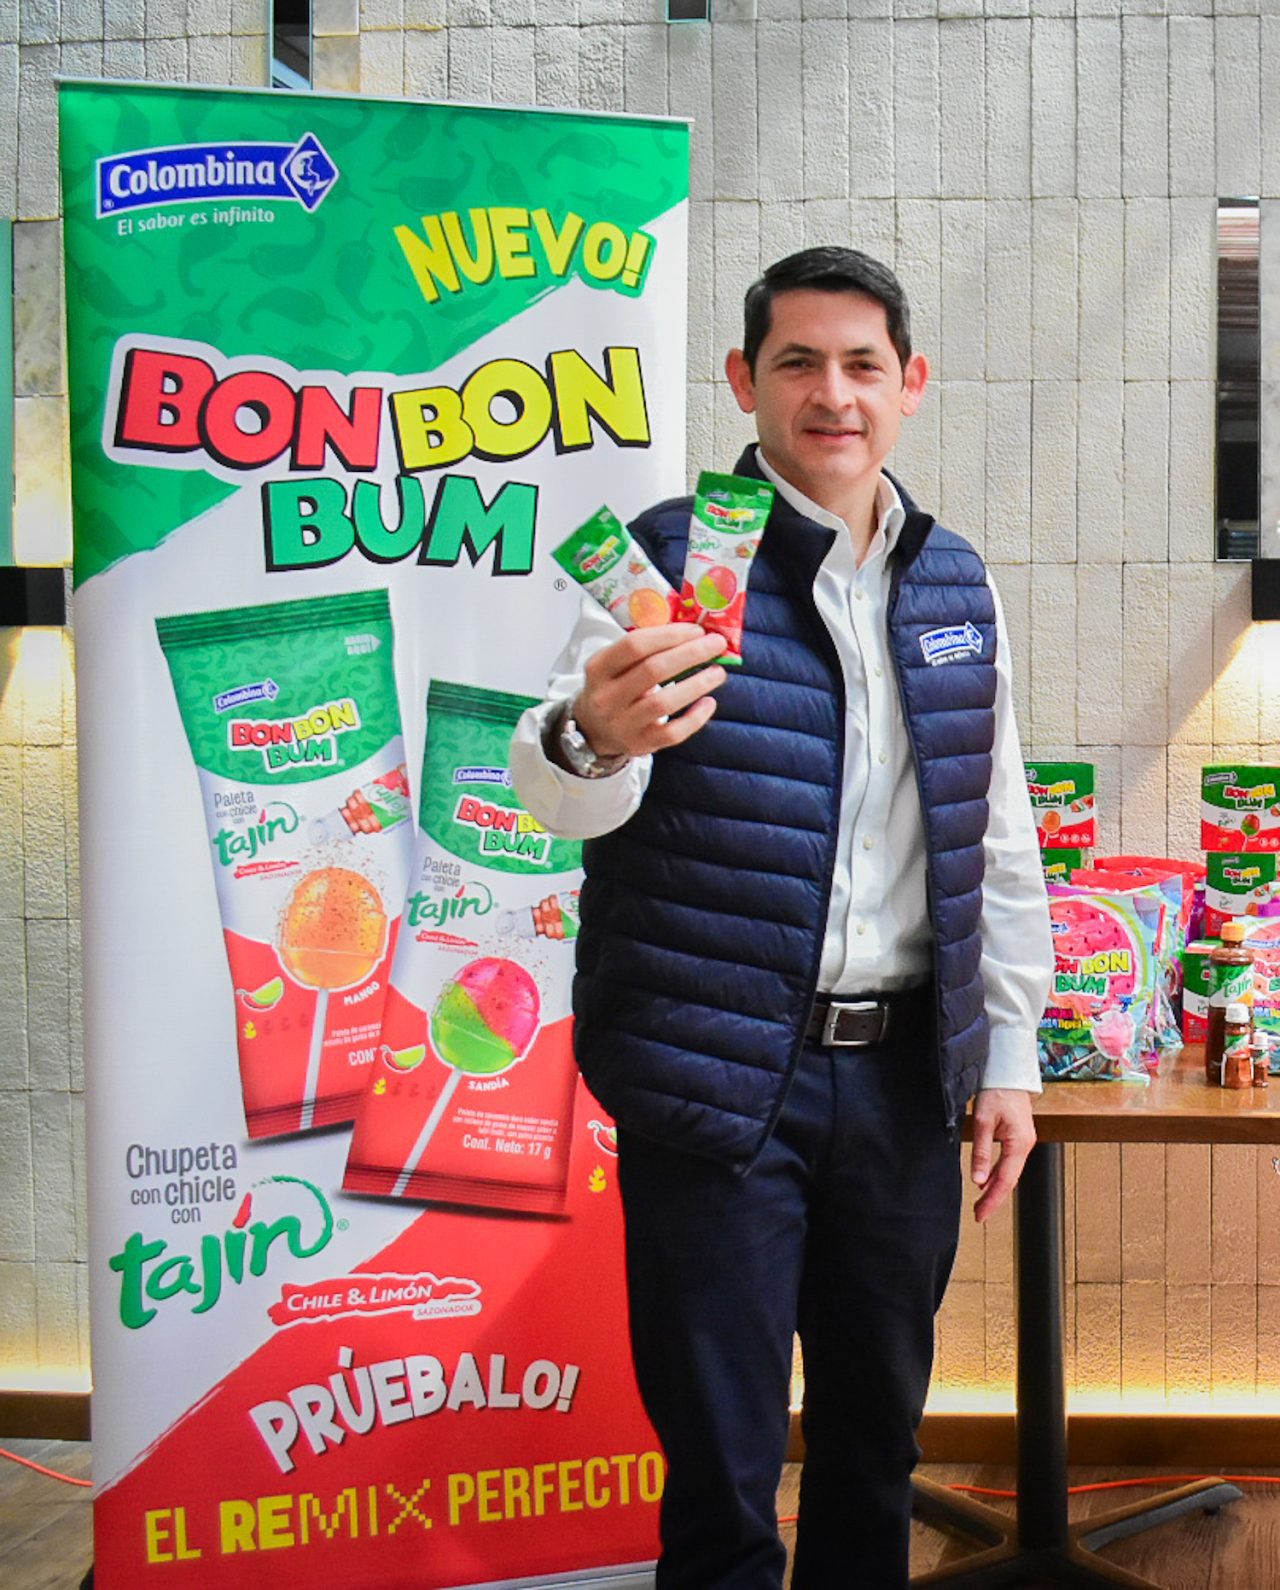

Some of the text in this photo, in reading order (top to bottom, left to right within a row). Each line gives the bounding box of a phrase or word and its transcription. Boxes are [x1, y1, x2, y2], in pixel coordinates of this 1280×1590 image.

[109, 150, 276, 198] Colombina
[117, 206, 275, 236] El sabor es infinito
[393, 207, 650, 302] NUEVO!
[114, 346, 651, 473] BON BON
[261, 474, 539, 576] BUM
[232, 702, 356, 747] BON BON
[266, 738, 332, 769] BUM
[214, 791, 254, 808] Paleta
[457, 798, 517, 830] BON
[483, 830, 548, 860] BUM
[423, 856, 462, 877] Paleta
[1081, 952, 1129, 975] BON
[343, 980, 381, 1006] MANGO
[1055, 975, 1107, 996] BUM
[467, 1076, 510, 1092] SANDÍA
[126, 1143, 237, 1179] Chupeta
[495, 1138, 524, 1155] Neto:
[528, 1142, 543, 1156] 17
[543, 1146, 552, 1160] g
[131, 1175, 236, 1207] con chicle
[171, 1205, 201, 1225] con
[287, 1279, 433, 1312] CHILE & LIMÓN
[417, 1303, 475, 1317] SAZONADOR
[248, 1345, 580, 1474] PRÚEBALO!
[144, 1451, 666, 1564] EL REMIX PERFECTO
